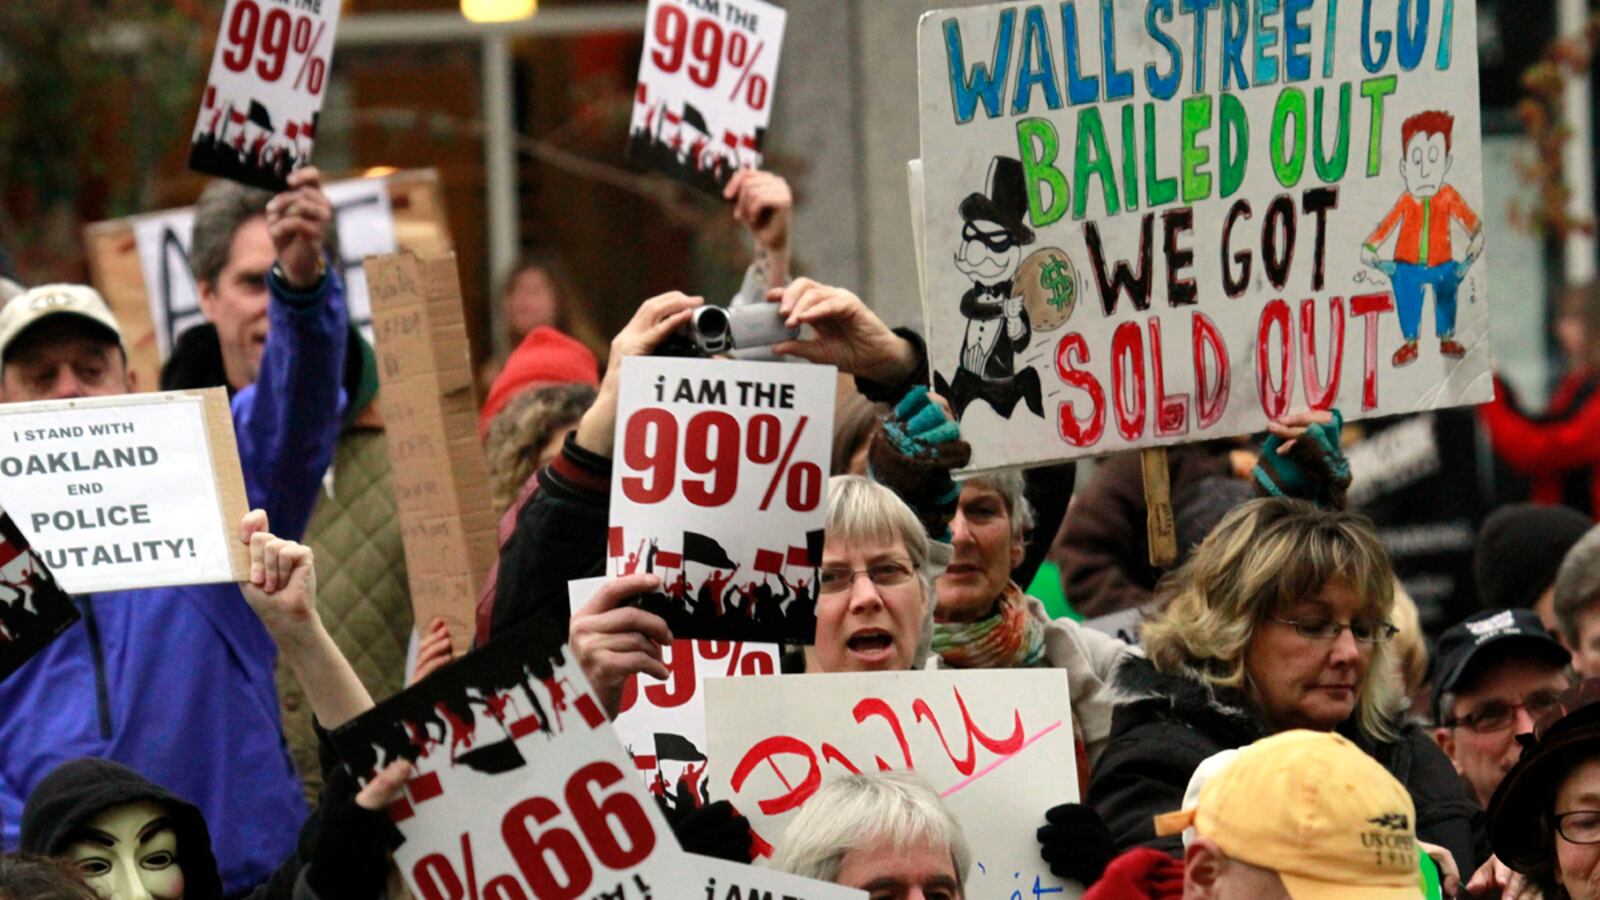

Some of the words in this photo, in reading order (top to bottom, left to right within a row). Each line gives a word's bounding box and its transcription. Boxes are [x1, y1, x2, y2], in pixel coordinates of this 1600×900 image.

[222, 0, 326, 96] 99%
[726, 3, 760, 34] THE
[652, 4, 768, 111] 99%
[942, 0, 1134, 125] WALL
[1143, 0, 1335, 101] STREET
[1360, 0, 1454, 74] GOT
[1015, 92, 1250, 227] BAILED
[1269, 76, 1397, 188] OUT
[1082, 207, 1198, 316] WE
[1221, 186, 1339, 298] GOT
[654, 375, 666, 402] i
[673, 378, 727, 405] AM
[736, 381, 796, 409] THE
[1055, 310, 1231, 447] SOLD
[1256, 291, 1395, 421] OUT
[0, 445, 159, 477] OAKLAND
[13, 431, 19, 442] I
[24, 426, 84, 441] STAND
[88, 421, 135, 437] WITH
[621, 407, 822, 513] 99%
[31, 504, 151, 533] POLICE
[67, 482, 104, 496] END
[39, 537, 197, 569] UTALITY!
[616, 638, 774, 708] 9%
